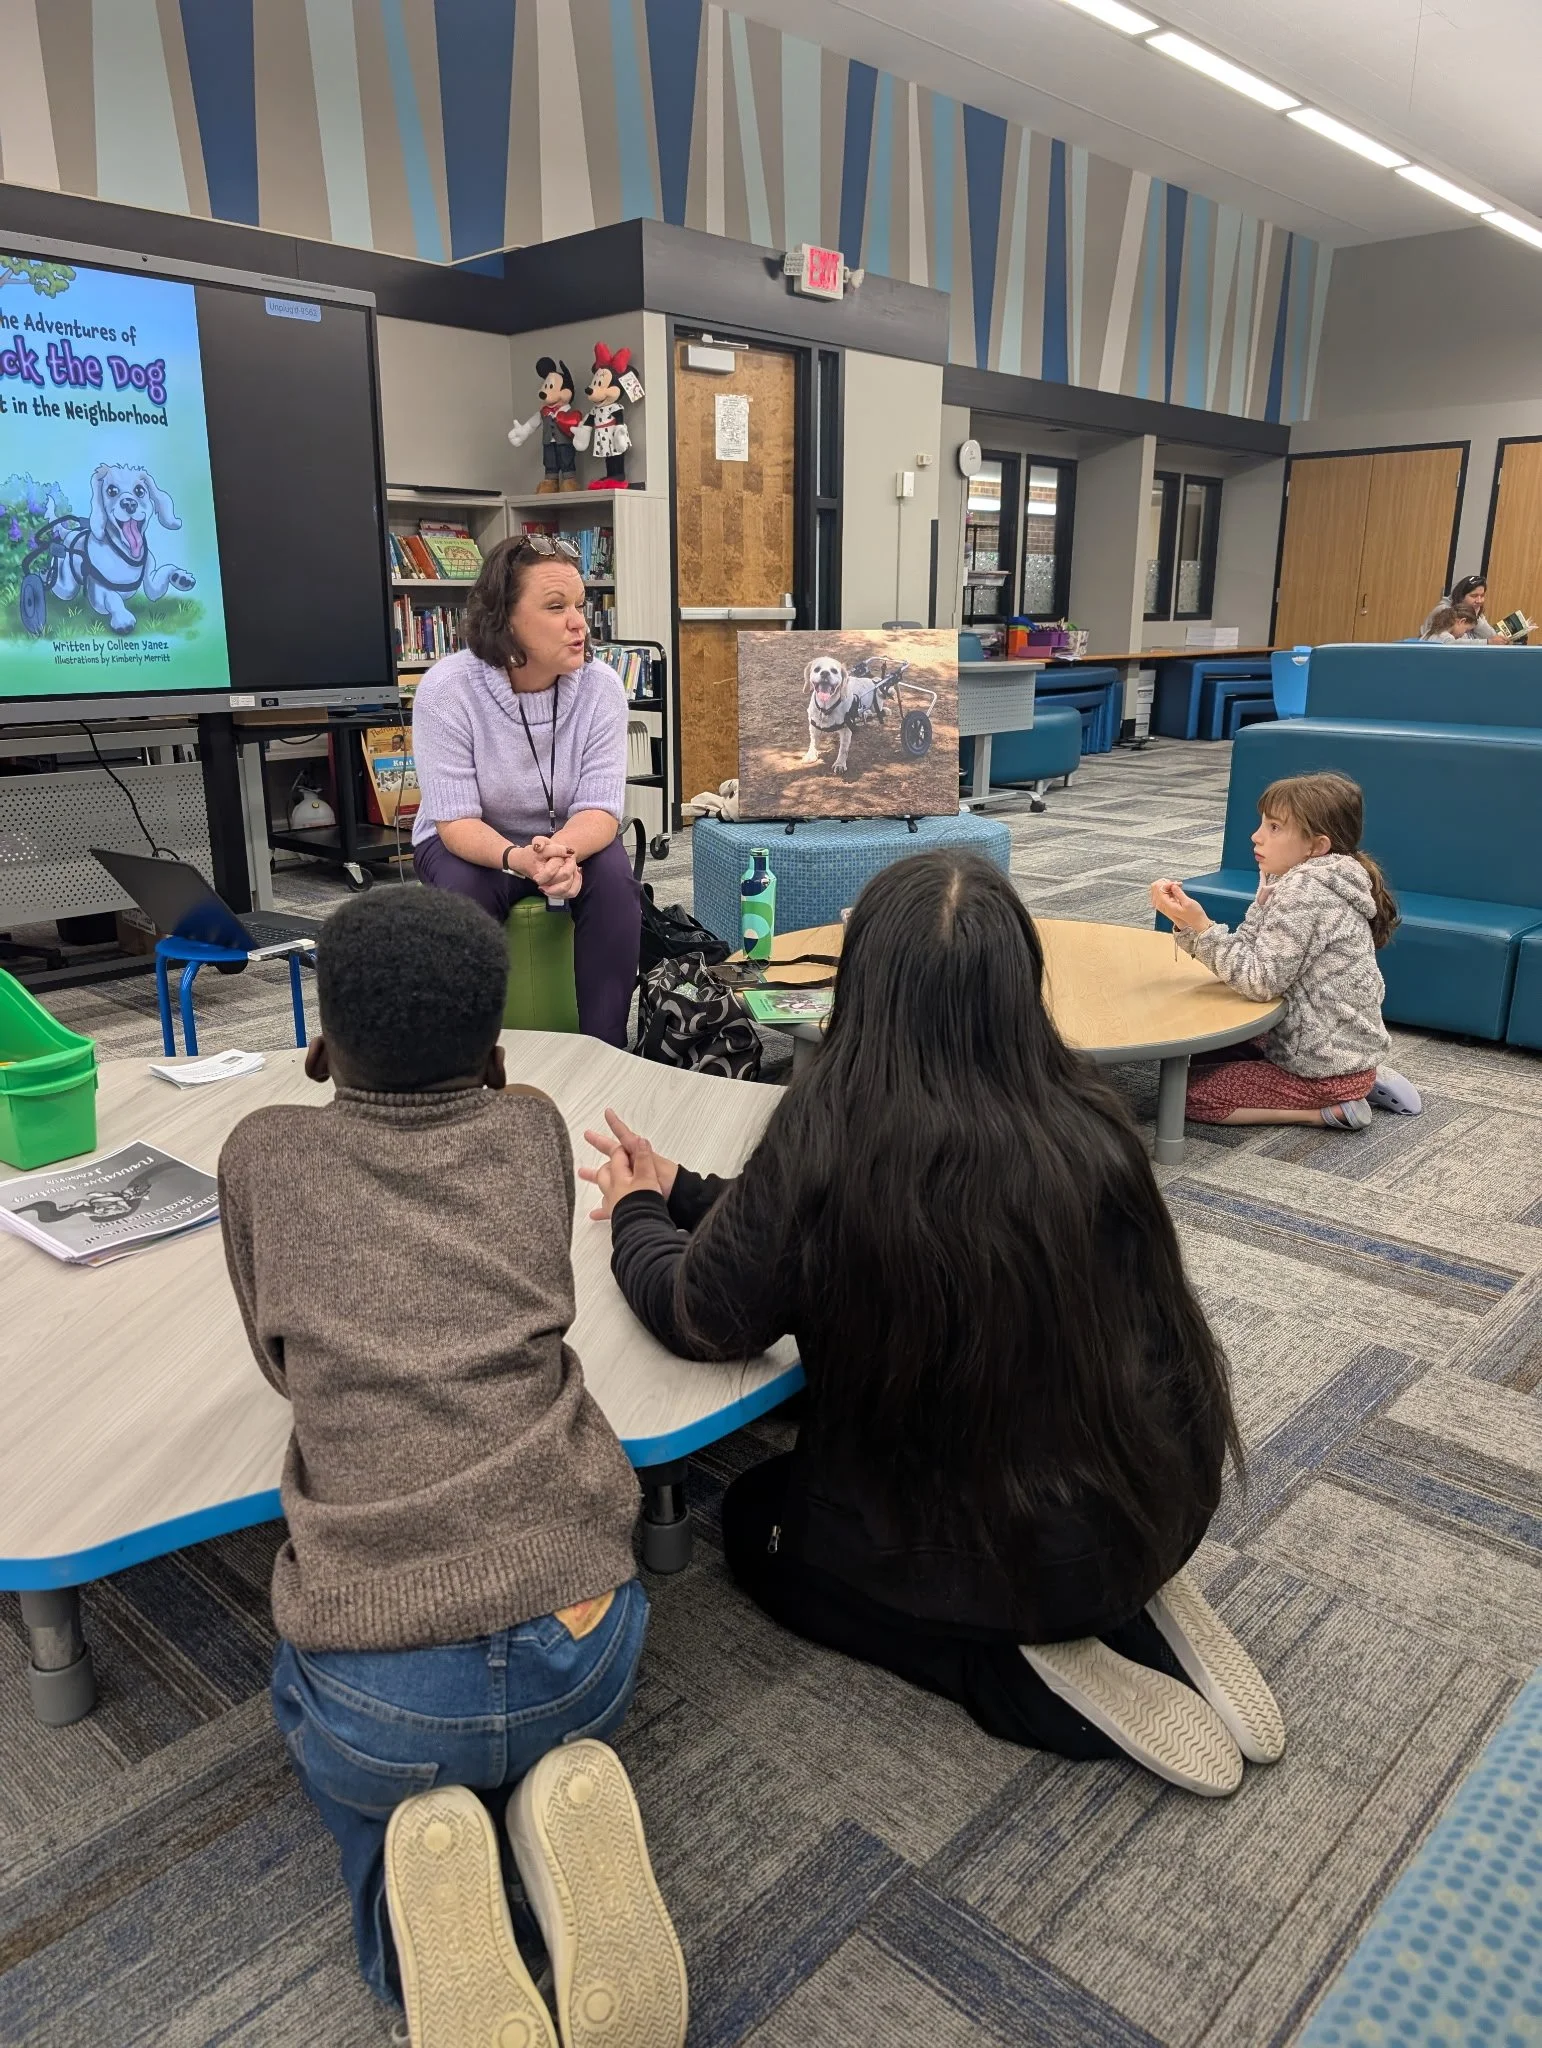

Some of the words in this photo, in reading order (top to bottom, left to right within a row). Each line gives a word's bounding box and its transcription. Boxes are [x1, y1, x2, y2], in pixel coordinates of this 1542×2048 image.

[0, 307, 19, 330] he
[24, 312, 117, 342] Adventures
[121, 325, 137, 346] of
[0, 334, 45, 386] ck
[46, 338, 103, 388] the
[107, 355, 167, 406] Dog
[12, 396, 28, 415] in
[33, 395, 60, 417] the
[64, 401, 168, 427] Neighborhood
[53, 640, 91, 652] Written
[93, 639, 105, 656] by
[107, 639, 140, 651] Colleen
[54, 655, 100, 665] Illustrations
[101, 656, 110, 666] by
[111, 653, 143, 666] Kimberly
[144, 653, 171, 663] Merritt
